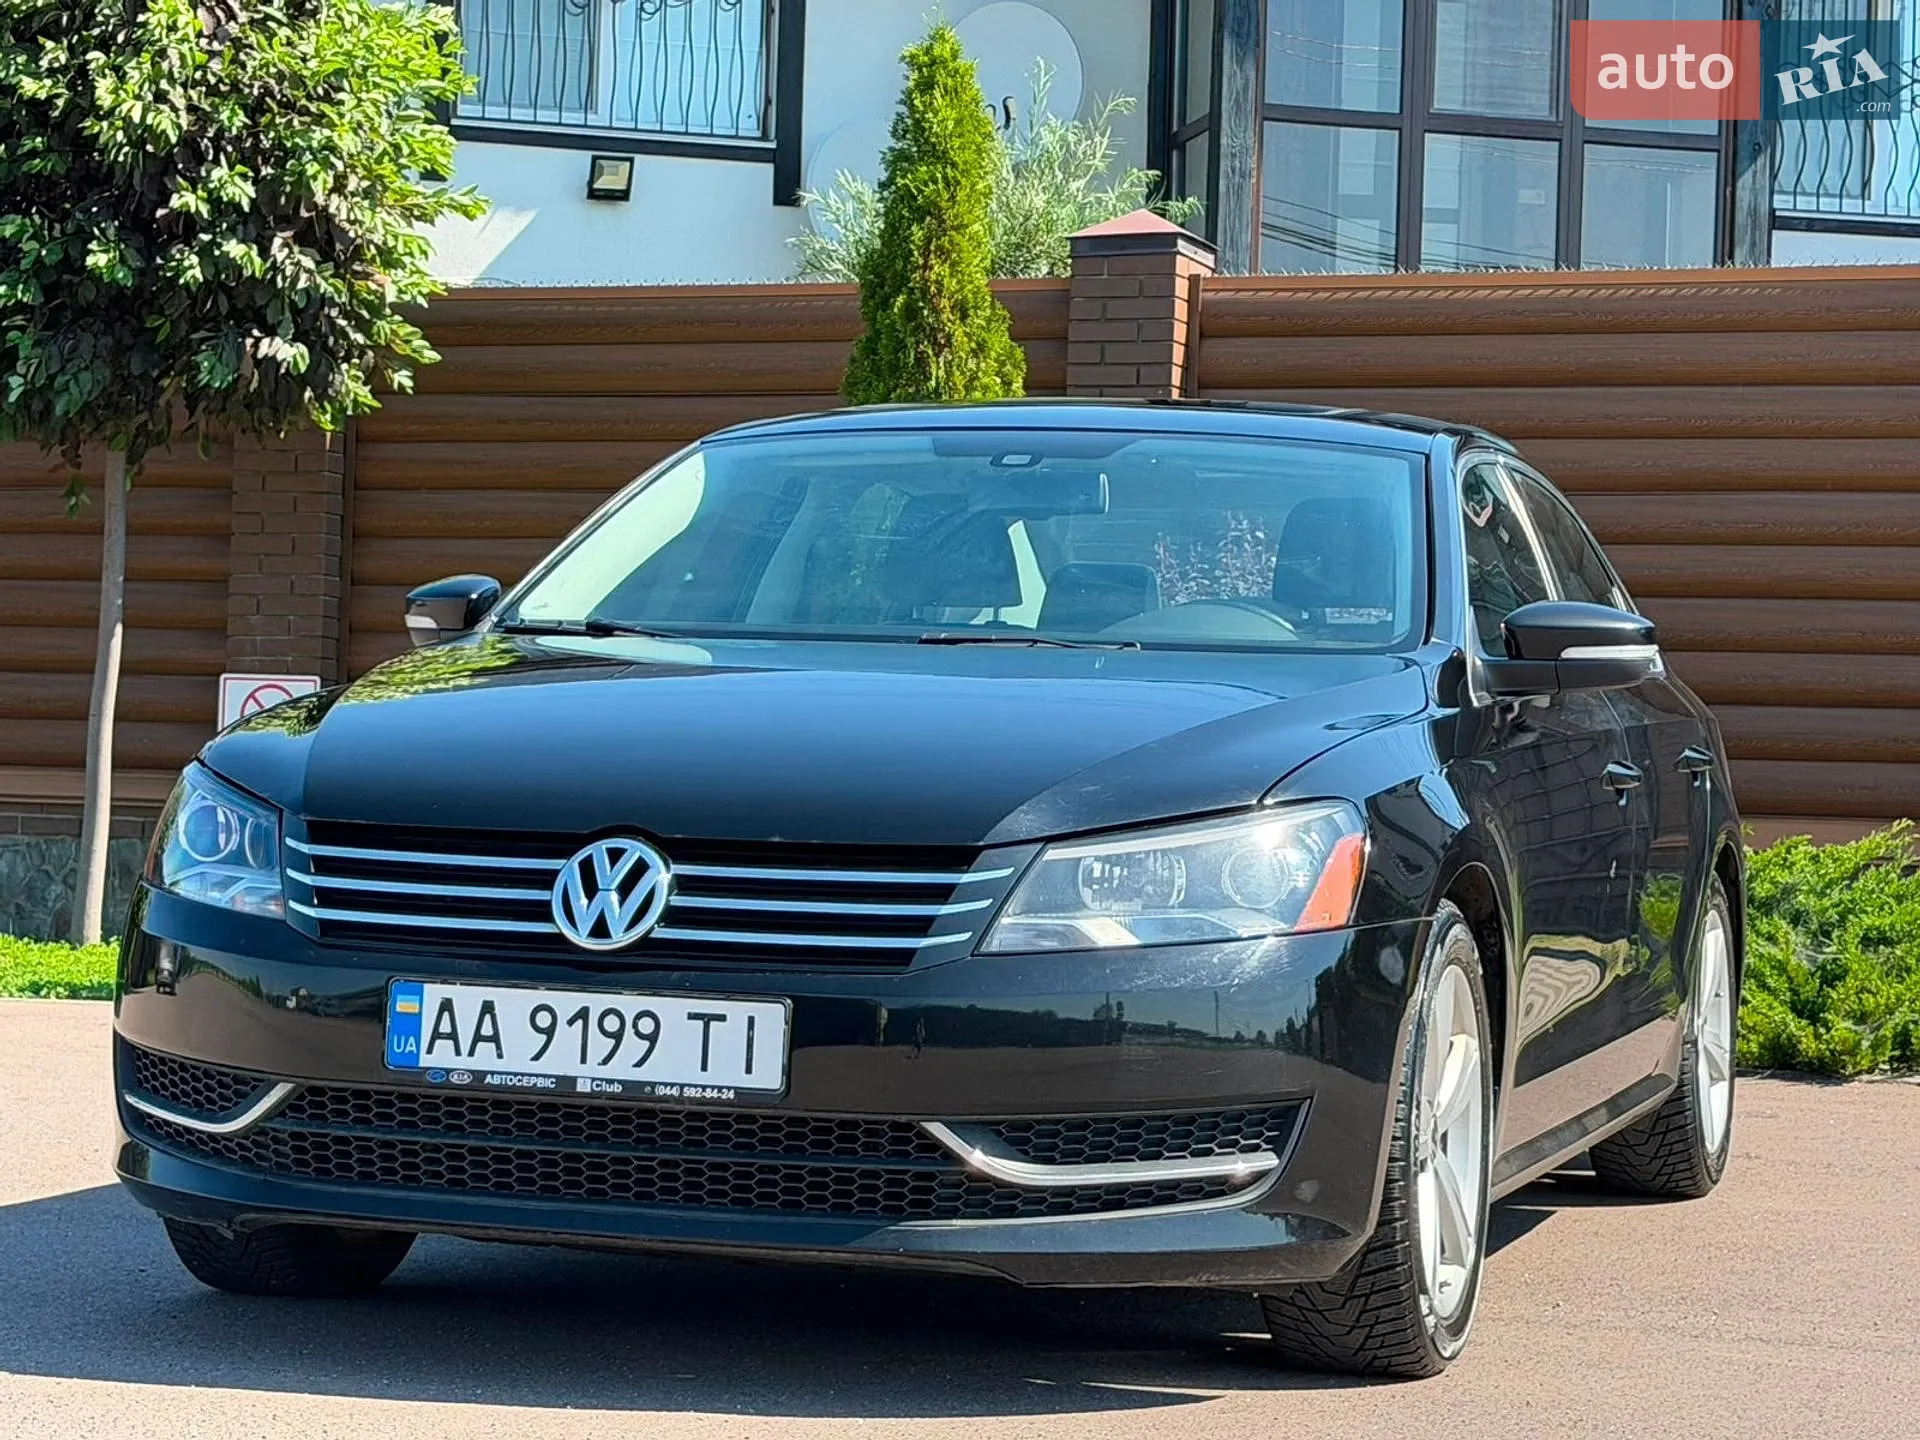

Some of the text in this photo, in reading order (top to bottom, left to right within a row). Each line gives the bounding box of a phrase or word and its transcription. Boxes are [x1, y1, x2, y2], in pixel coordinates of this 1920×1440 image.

[425, 996, 504, 1060] AA
[529, 1003, 662, 1069] 9199
[393, 1036, 417, 1054] UA
[592, 1080, 623, 1093] Club
[654, 1084, 681, 1097] (044)
